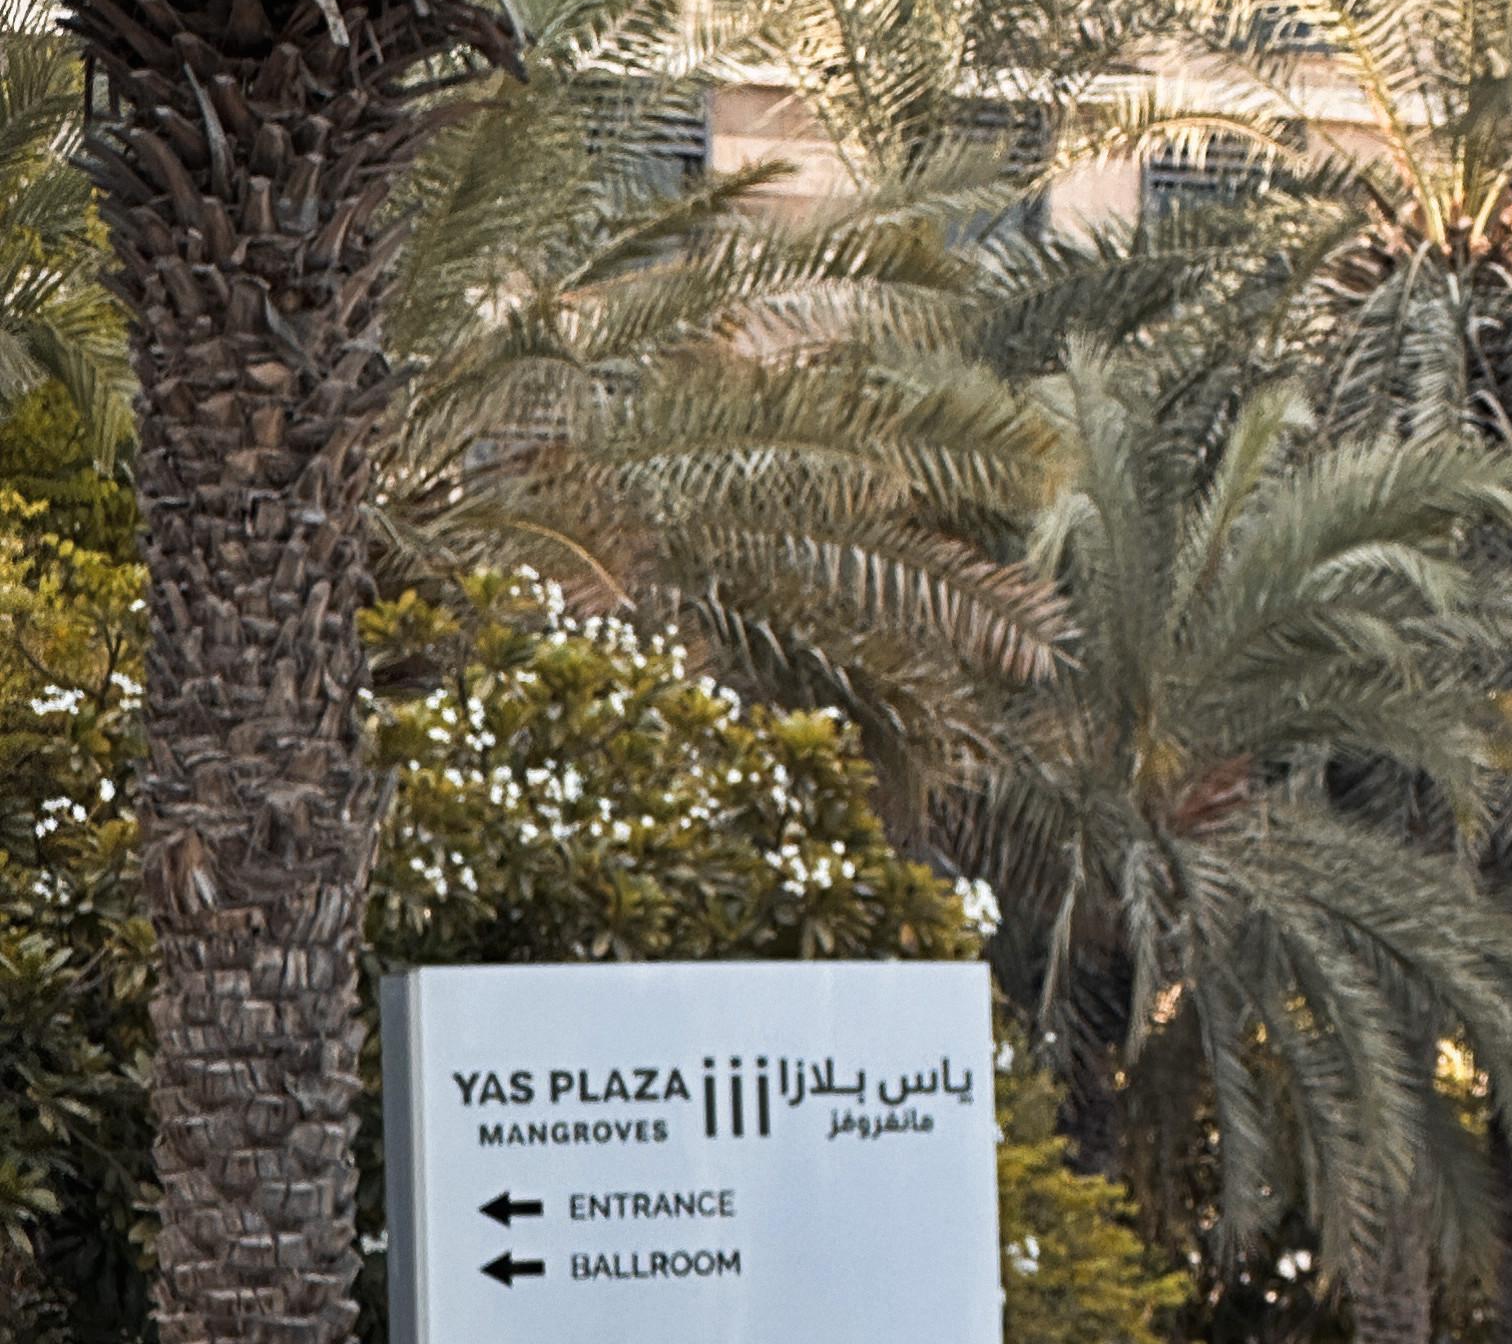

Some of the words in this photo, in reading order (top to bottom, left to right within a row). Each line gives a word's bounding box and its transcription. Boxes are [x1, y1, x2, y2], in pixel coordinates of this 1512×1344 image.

[453, 1069, 535, 1106] YAS
[549, 1066, 691, 1103] PLAZA
[779, 1057, 866, 1107] بلازا
[878, 1057, 973, 1106] ياس
[479, 1119, 668, 1146] MANGROVES
[569, 1190, 736, 1220] ENTRANCE
[571, 1249, 743, 1280] BALLROOM
